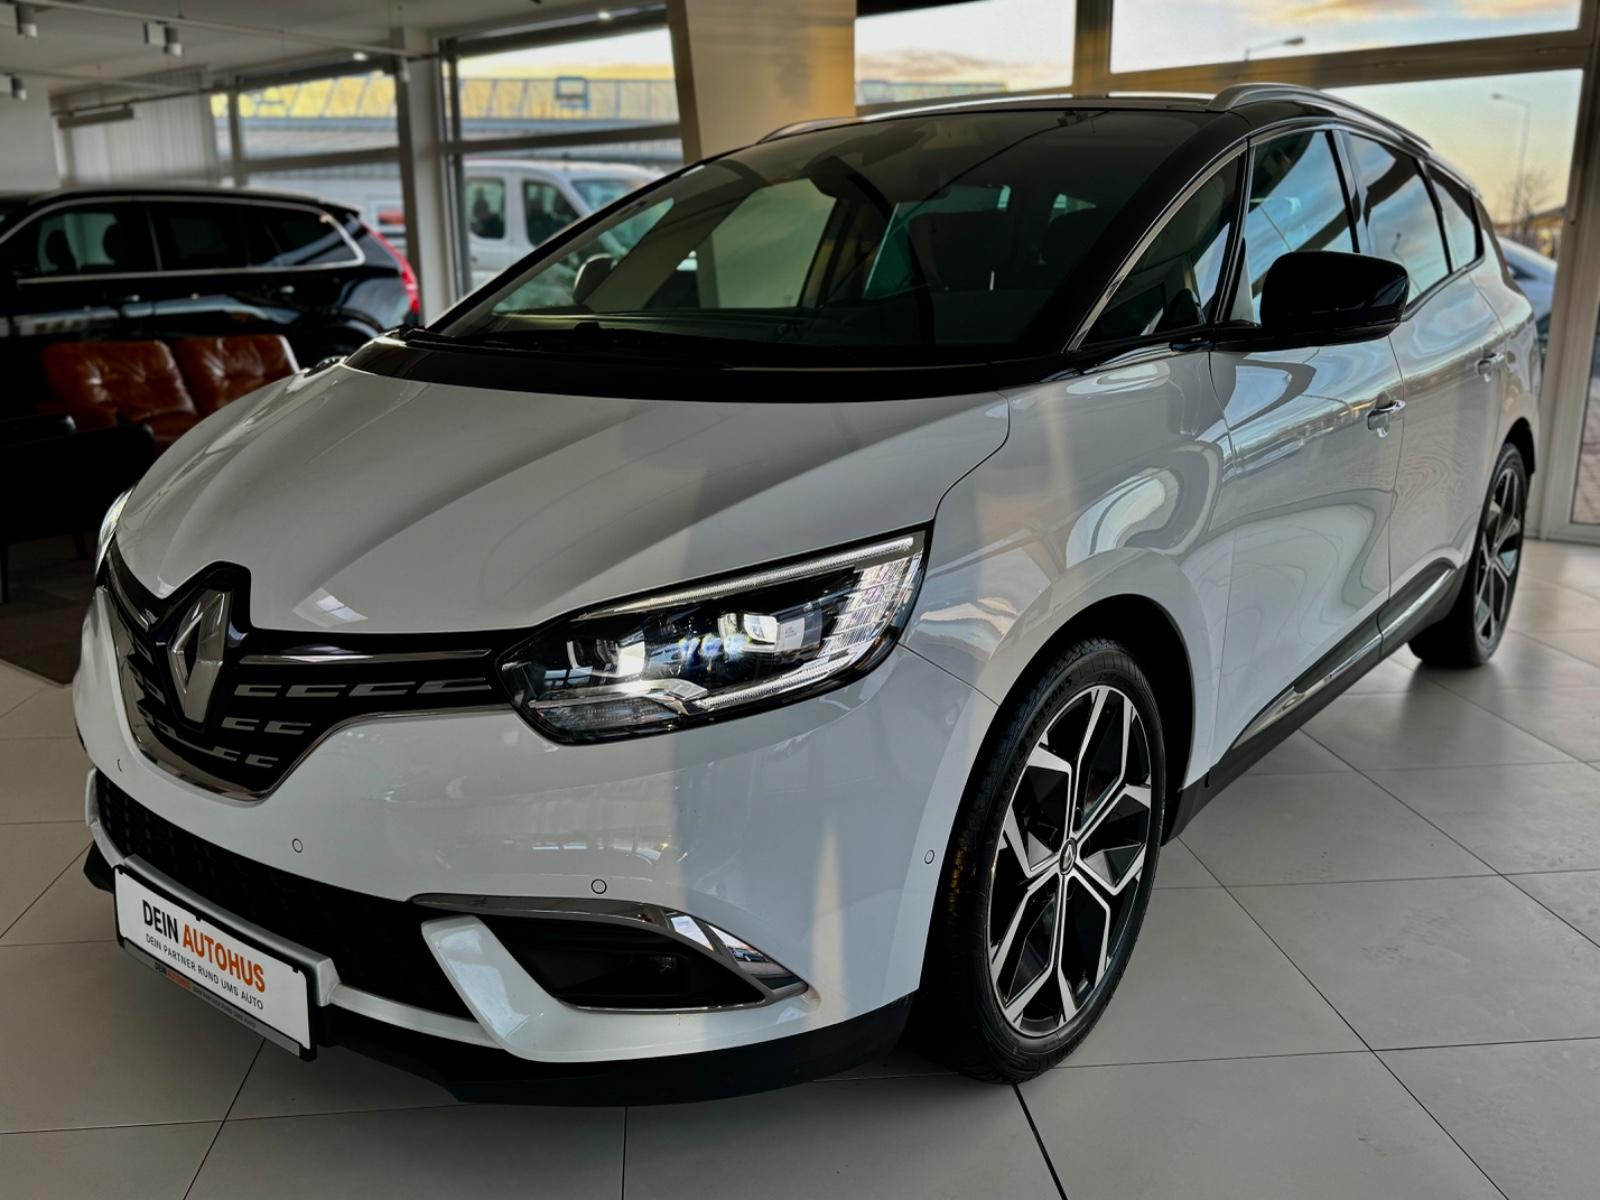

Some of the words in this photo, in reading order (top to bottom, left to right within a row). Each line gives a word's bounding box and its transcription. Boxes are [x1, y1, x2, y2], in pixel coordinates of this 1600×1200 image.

[142, 899, 179, 944] DEIN
[183, 923, 266, 993] AUTOHUS
[145, 933, 162, 950] DEIN
[163, 944, 196, 972] PARTNER
[197, 965, 219, 985] RUND
[220, 978, 239, 997] UMS
[241, 991, 264, 1010] AUTO
